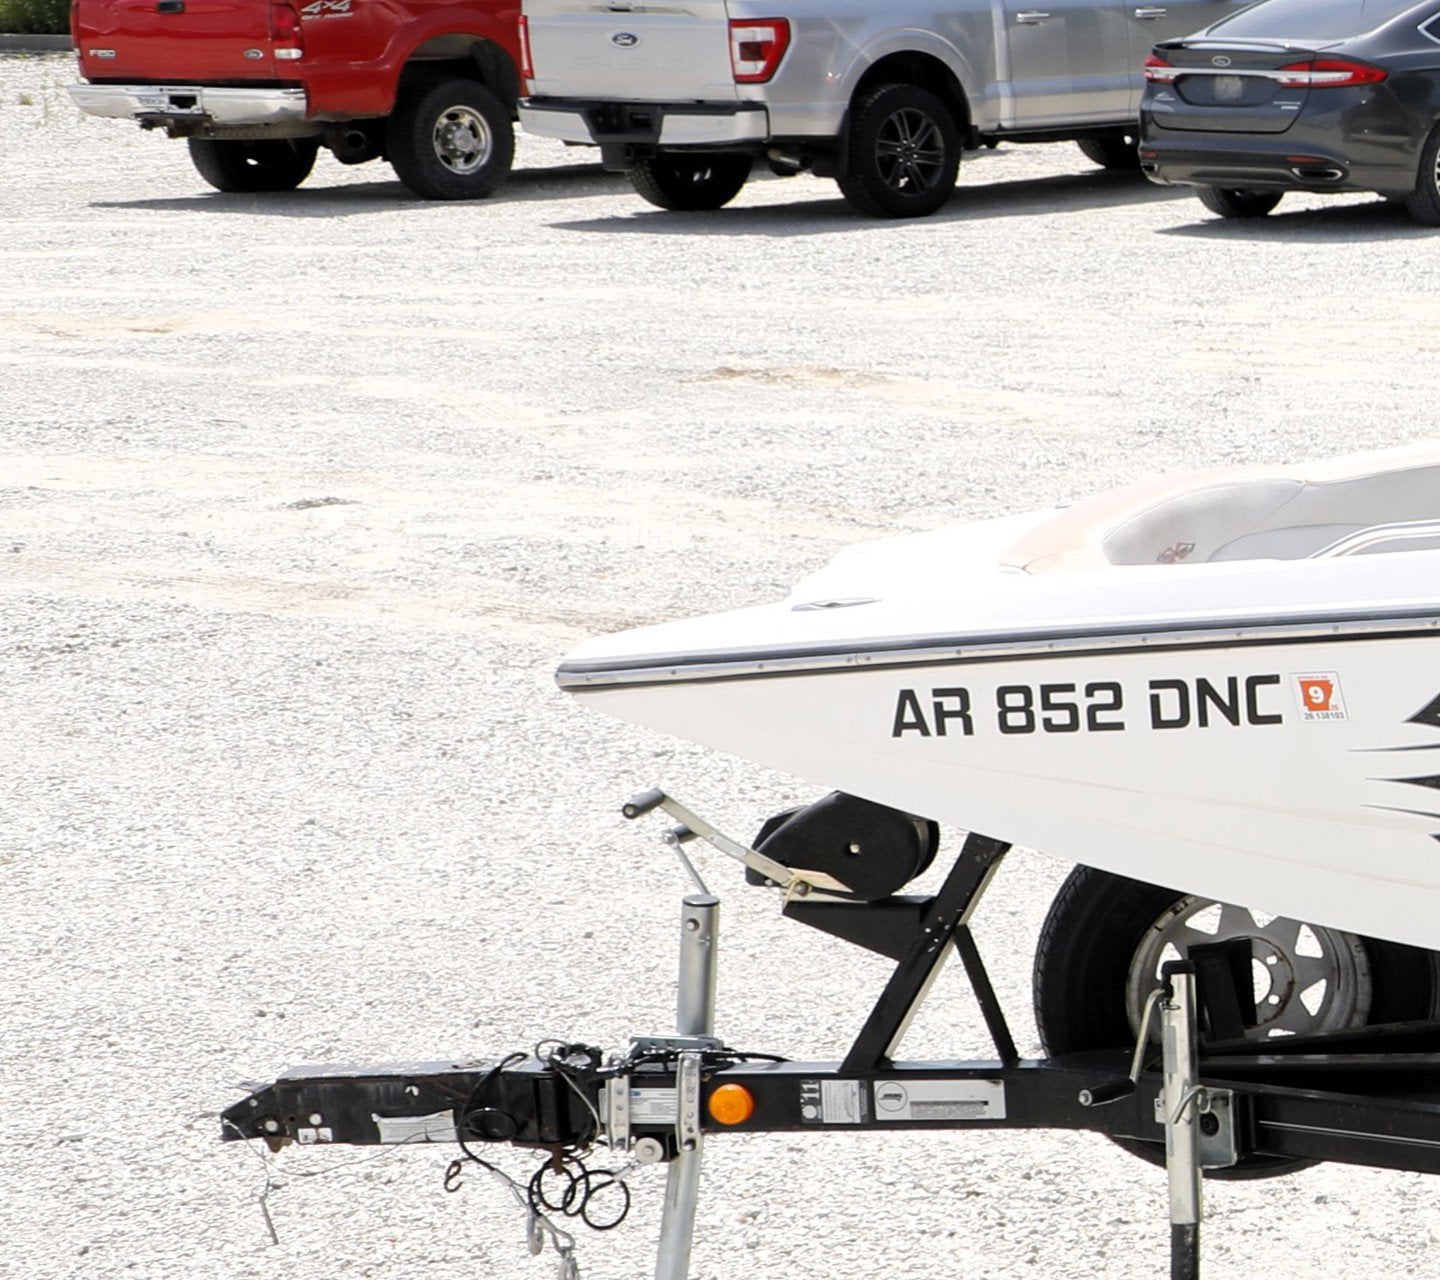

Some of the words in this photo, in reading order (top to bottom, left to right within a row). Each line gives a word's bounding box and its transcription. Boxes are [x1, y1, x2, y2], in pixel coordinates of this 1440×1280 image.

[893, 688, 973, 737] AR
[997, 682, 1124, 734] 852
[1150, 675, 1282, 729] DNC
[1308, 685, 1325, 704] 9
